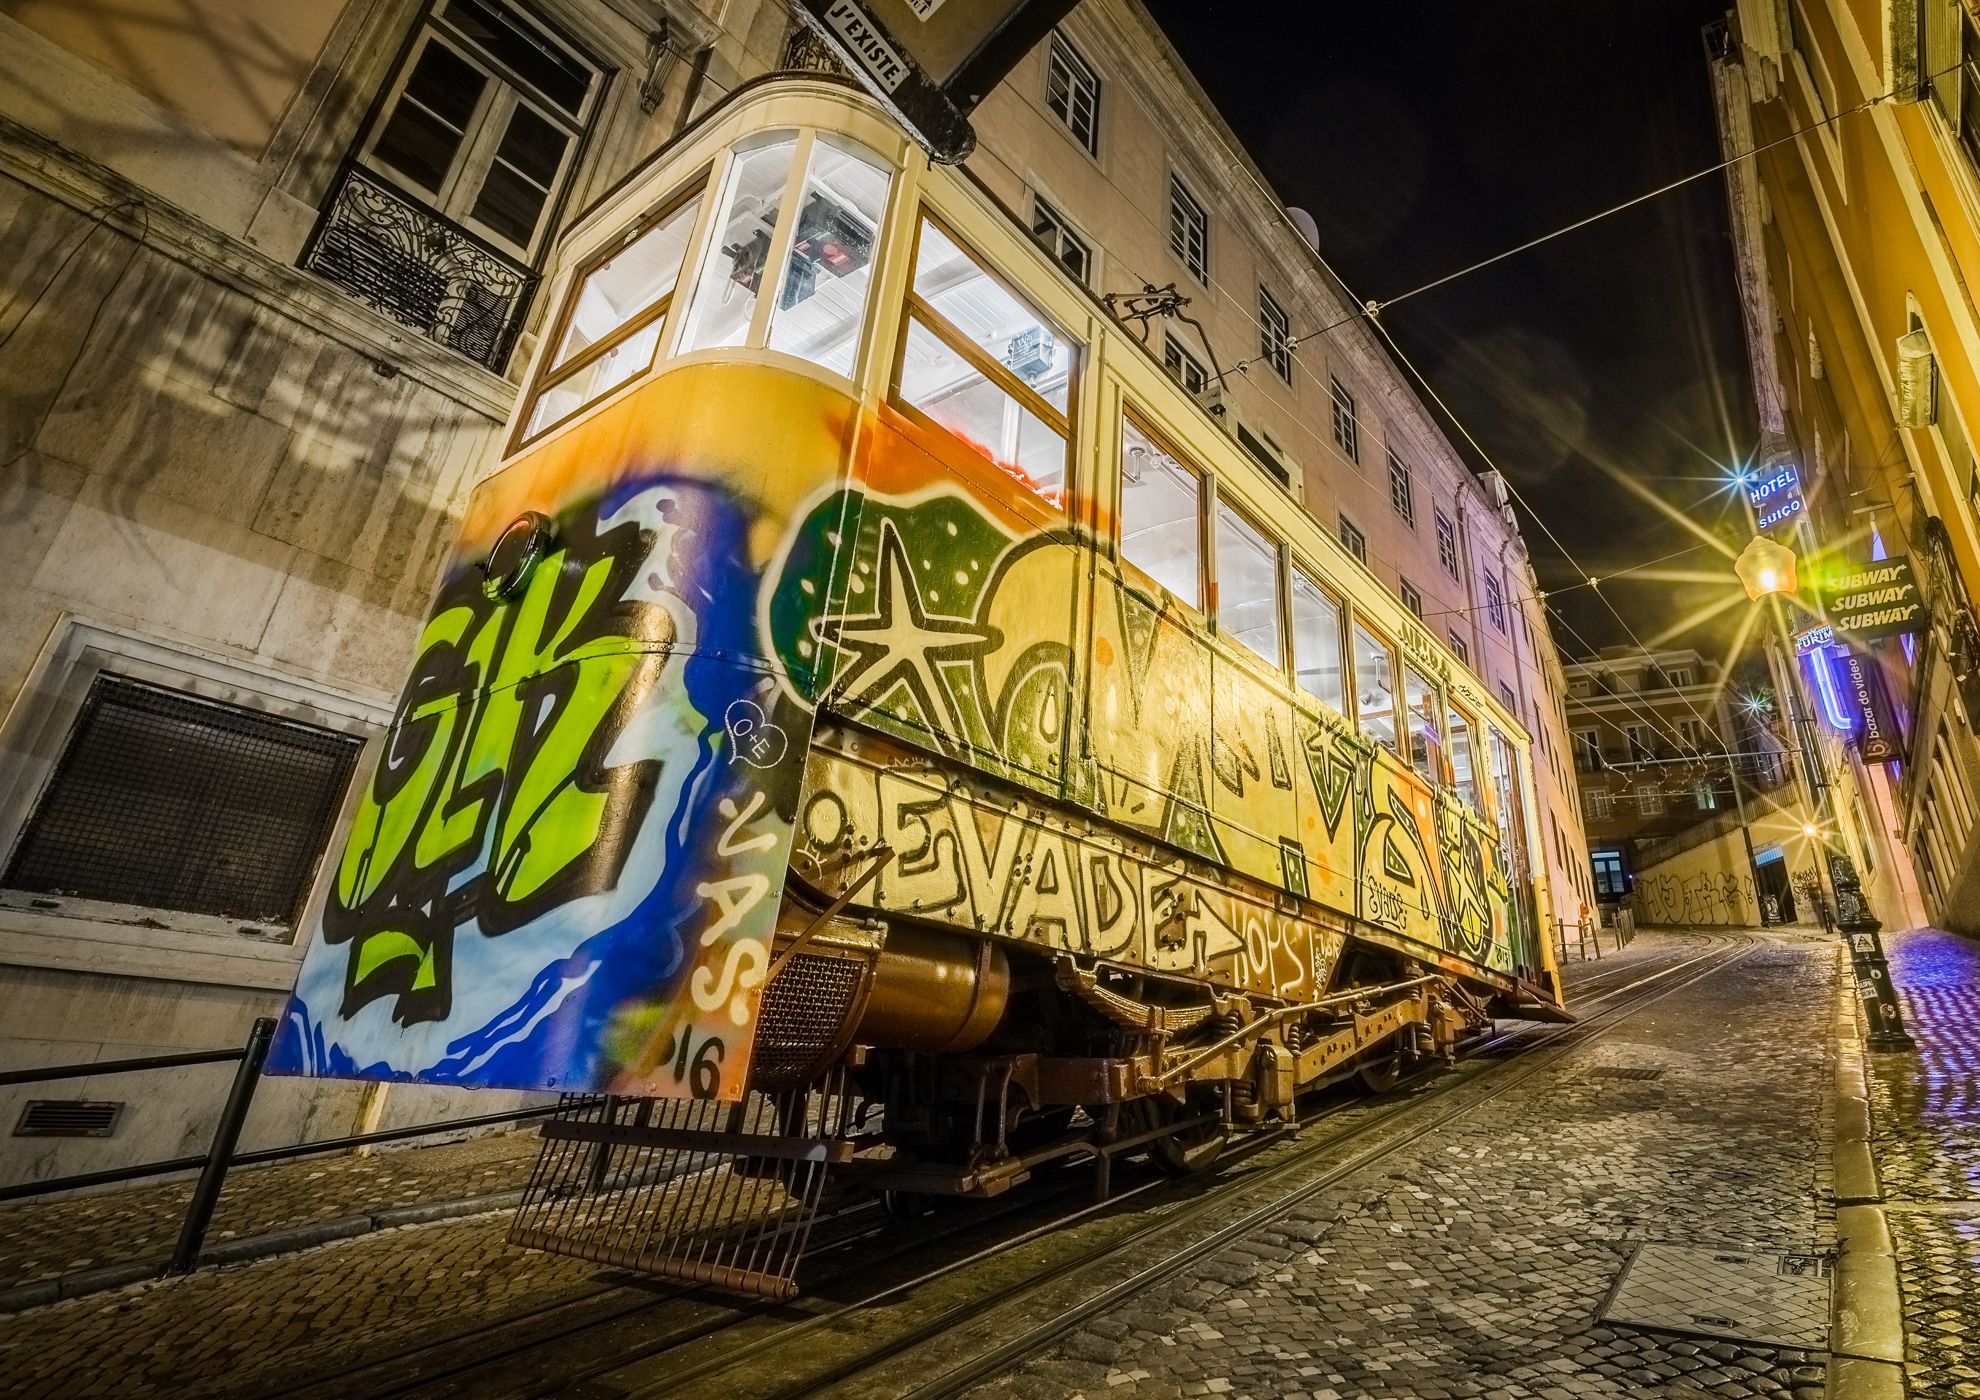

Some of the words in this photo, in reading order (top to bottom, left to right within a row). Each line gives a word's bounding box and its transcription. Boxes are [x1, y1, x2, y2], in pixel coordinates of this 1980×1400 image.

[830, 4, 901, 87] J'EXISTE.
[1750, 471, 1795, 504] HOTEL
[1759, 500, 1801, 529] SUIÇO
[1825, 564, 1907, 593] SUBWAY
[1830, 584, 1914, 613] SUBWAY
[1836, 604, 1920, 632] SUBWAY
[1858, 690, 1870, 705] do
[1864, 707, 1880, 739] bazar
